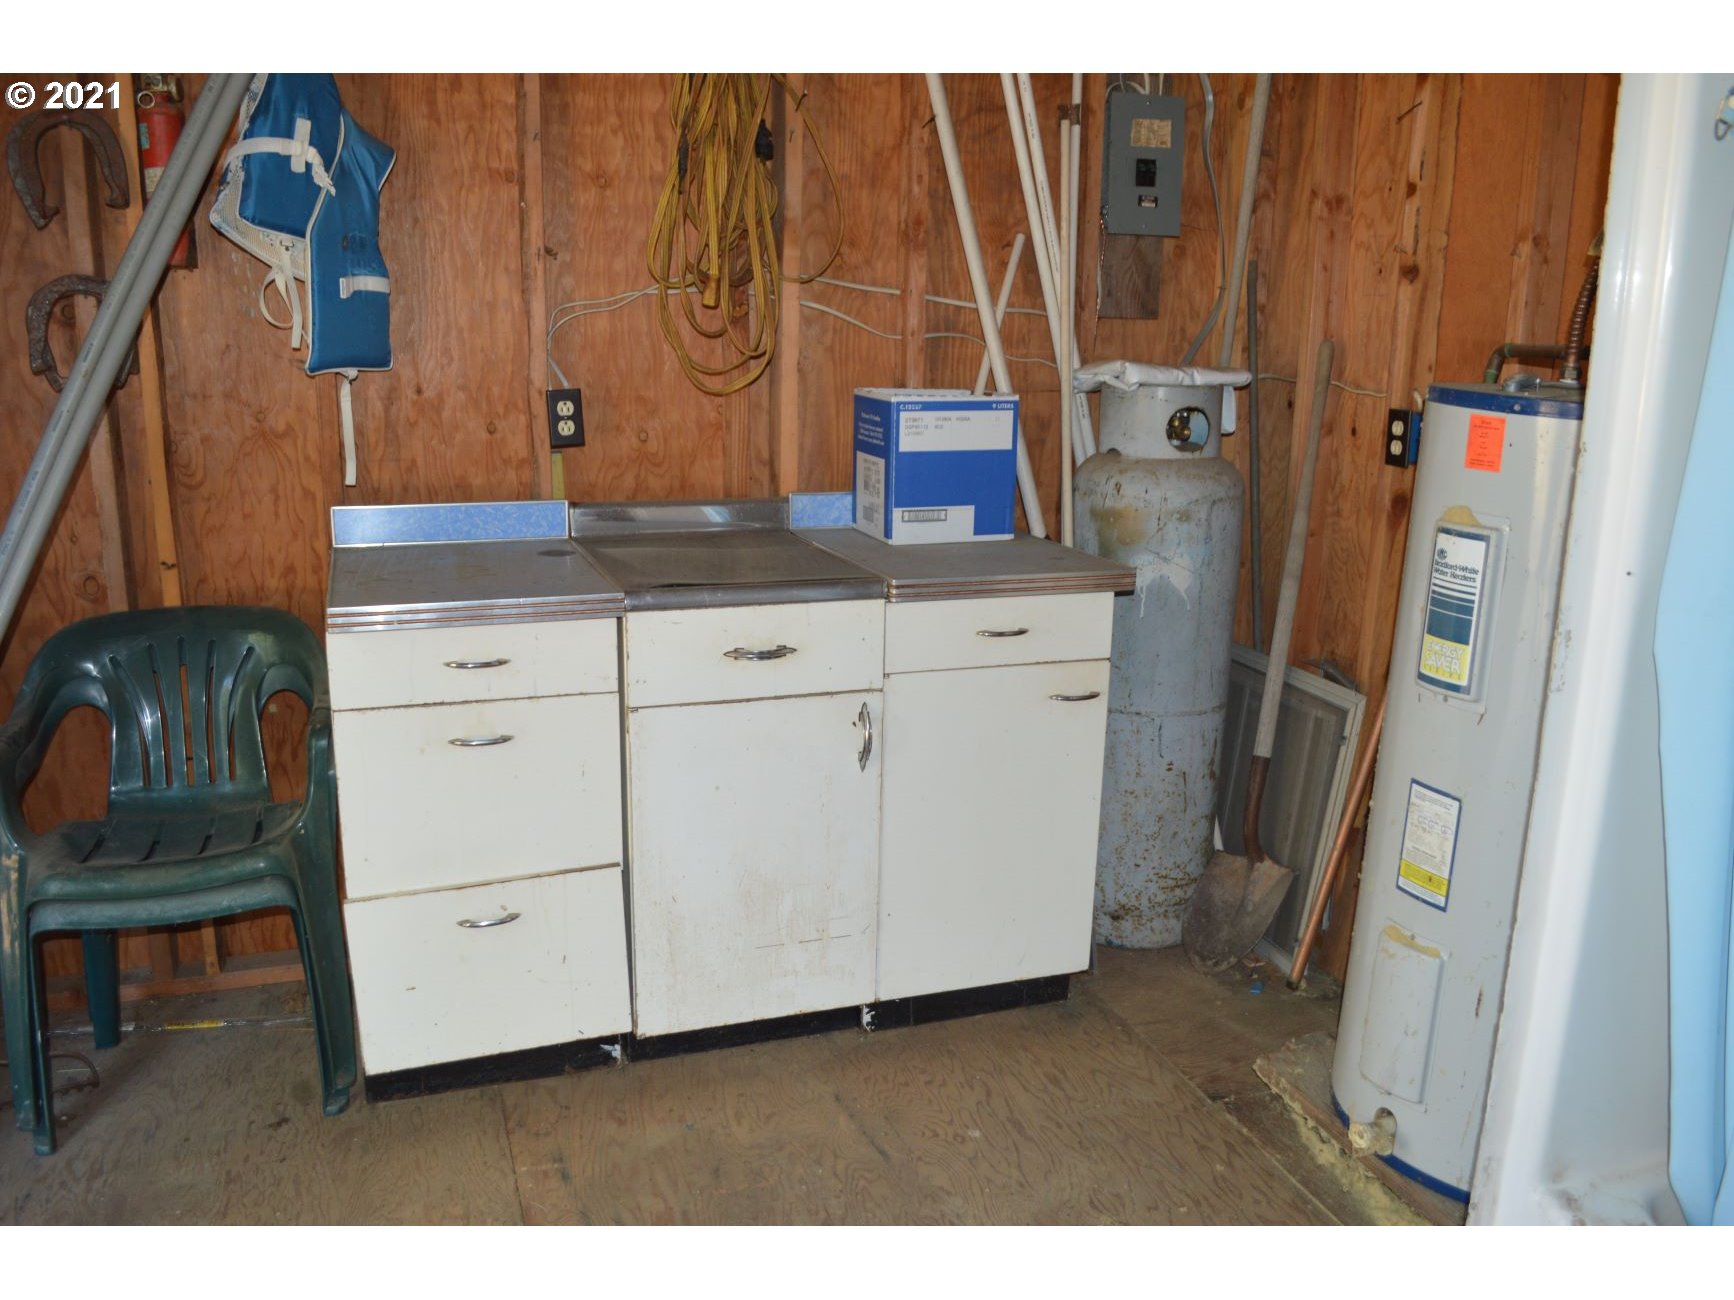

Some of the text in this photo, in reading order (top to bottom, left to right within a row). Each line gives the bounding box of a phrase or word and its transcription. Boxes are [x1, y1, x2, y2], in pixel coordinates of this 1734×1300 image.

[1433, 566, 1476, 583] Water Heaters
[1427, 641, 1464, 658] ENERGY
[1425, 652, 1461, 673] SAVER
